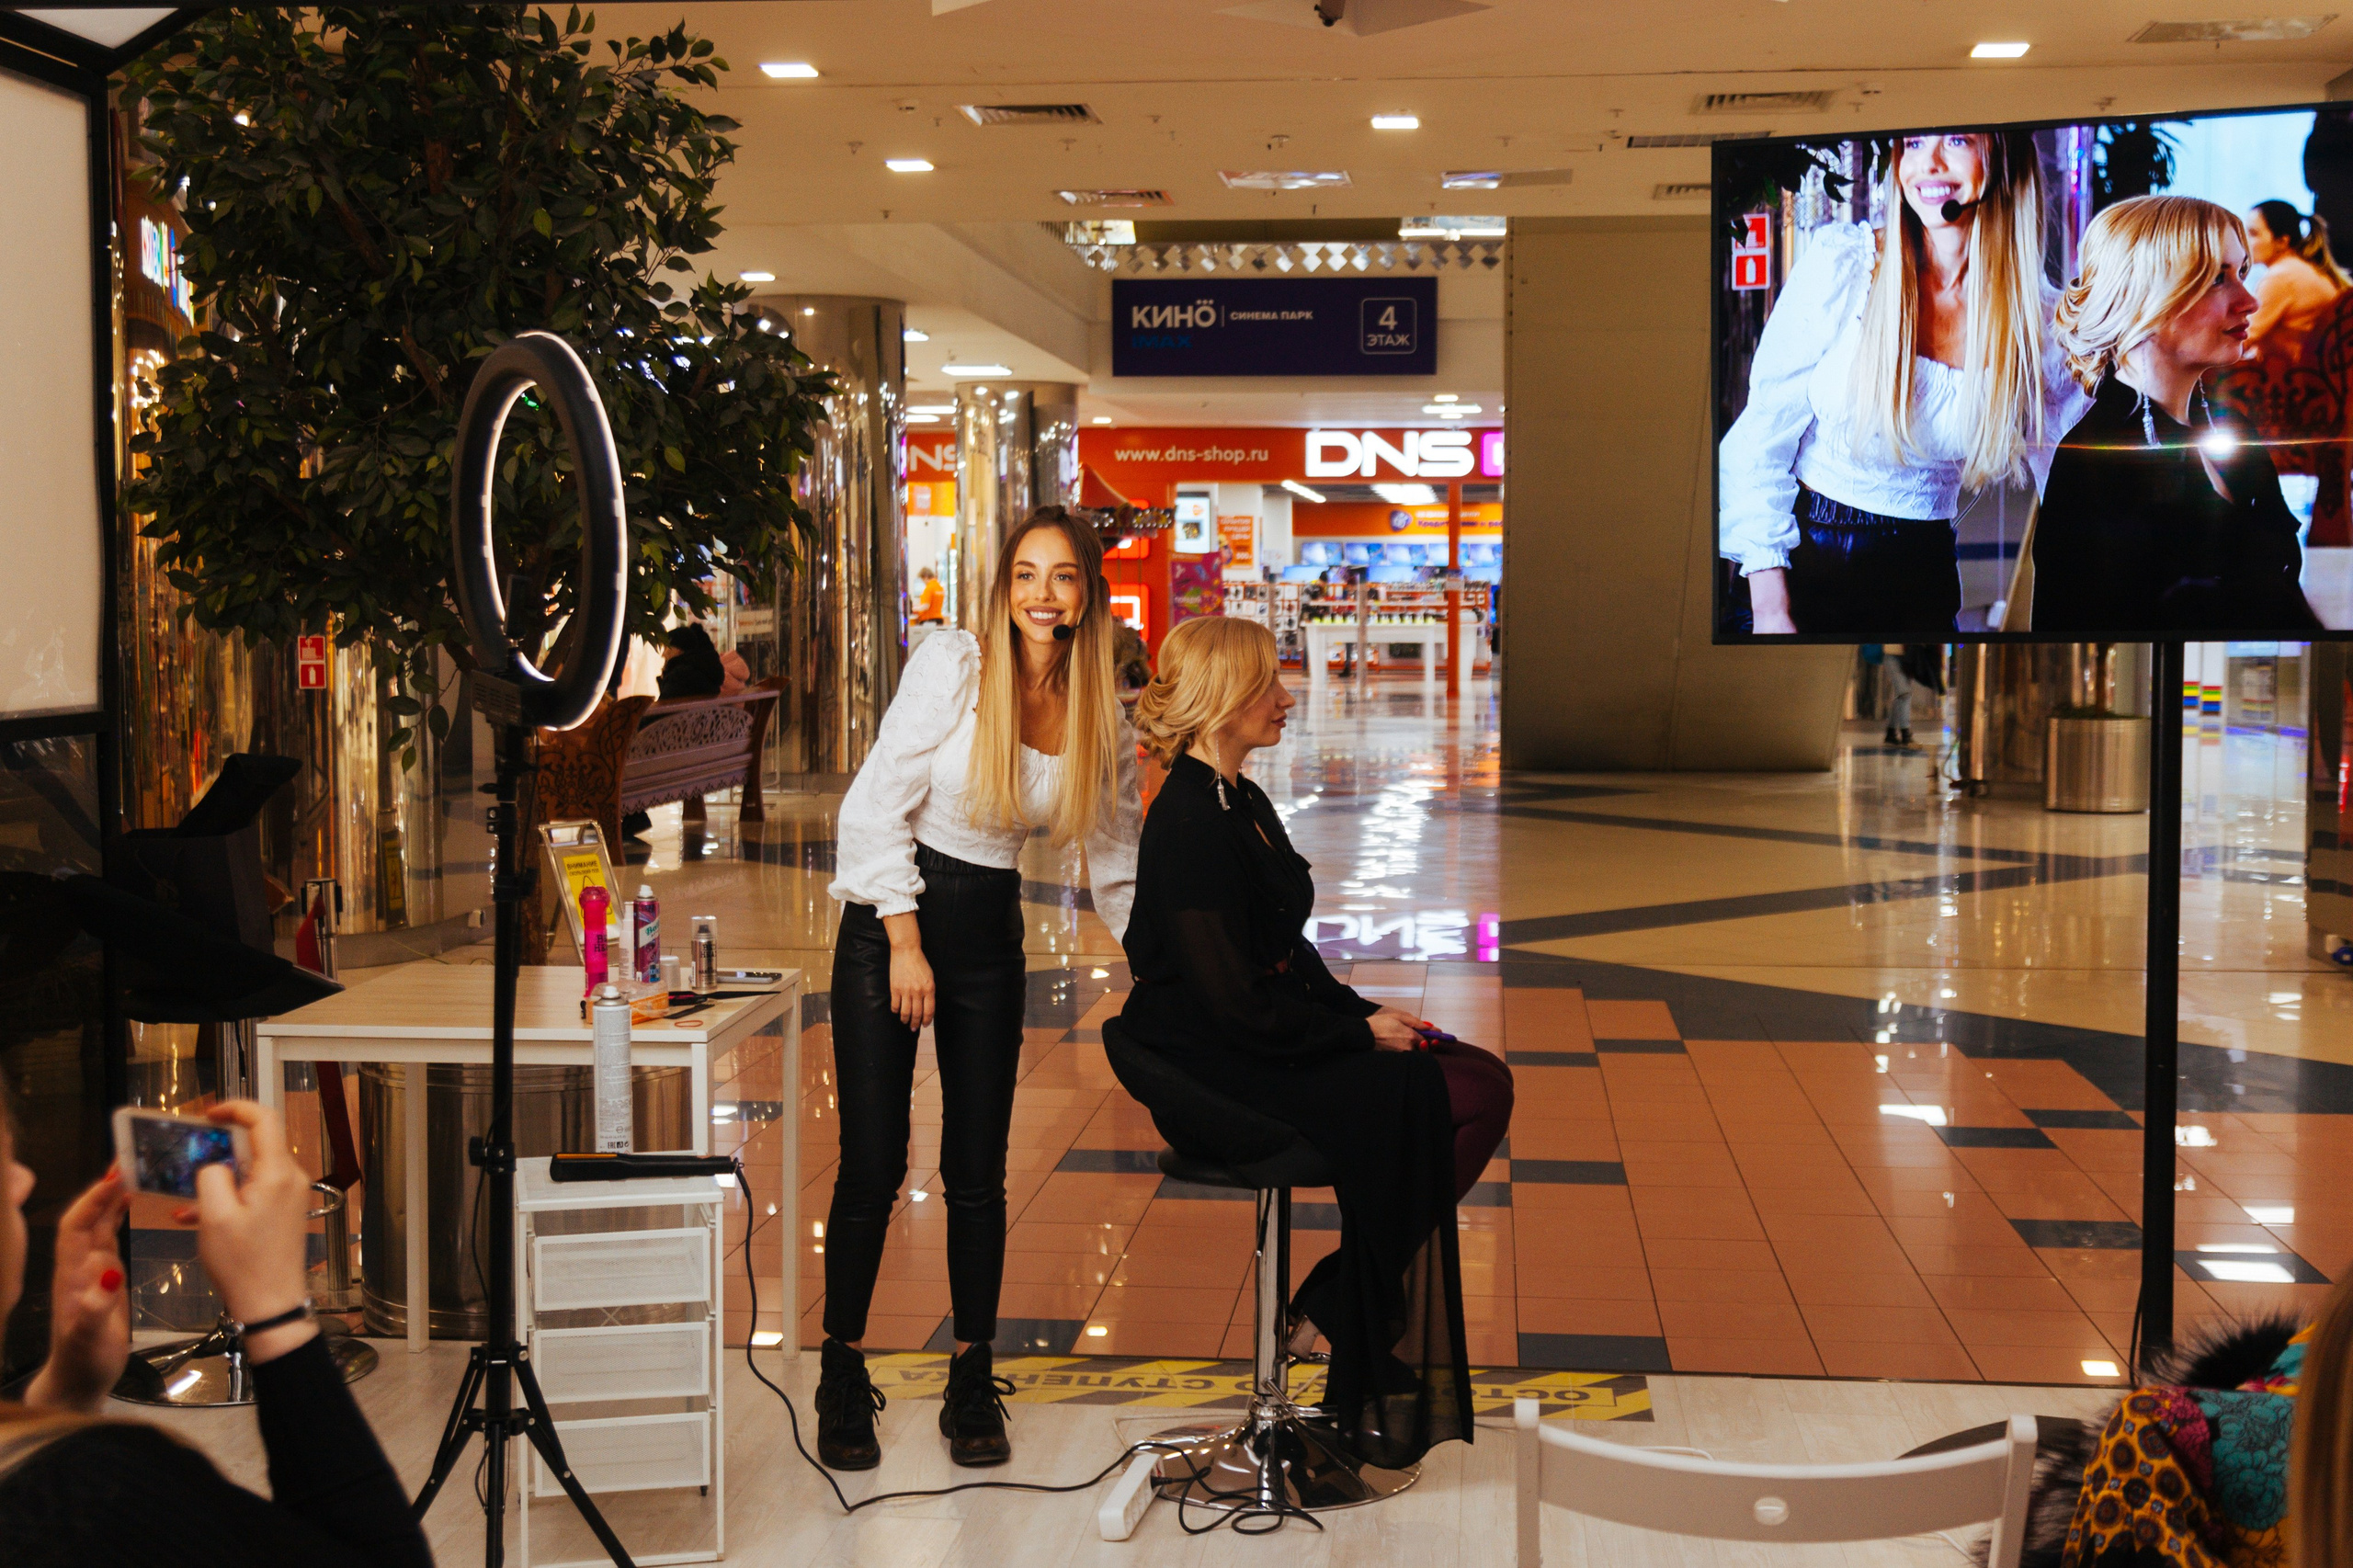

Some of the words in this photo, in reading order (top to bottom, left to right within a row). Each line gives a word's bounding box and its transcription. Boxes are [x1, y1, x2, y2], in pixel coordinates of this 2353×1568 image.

[1230, 311, 1278, 321] СИНЕМА
[1280, 310, 1314, 320] ПАРК
[1379, 305, 1398, 331] 4
[1131, 335, 1193, 348] IMAX
[1367, 334, 1411, 347] ЭТАЖ
[1114, 445, 1269, 465] www.dns-shop.ru
[1305, 430, 1474, 477] DNS
[566, 860, 598, 870] ВНИМАНИЕ
